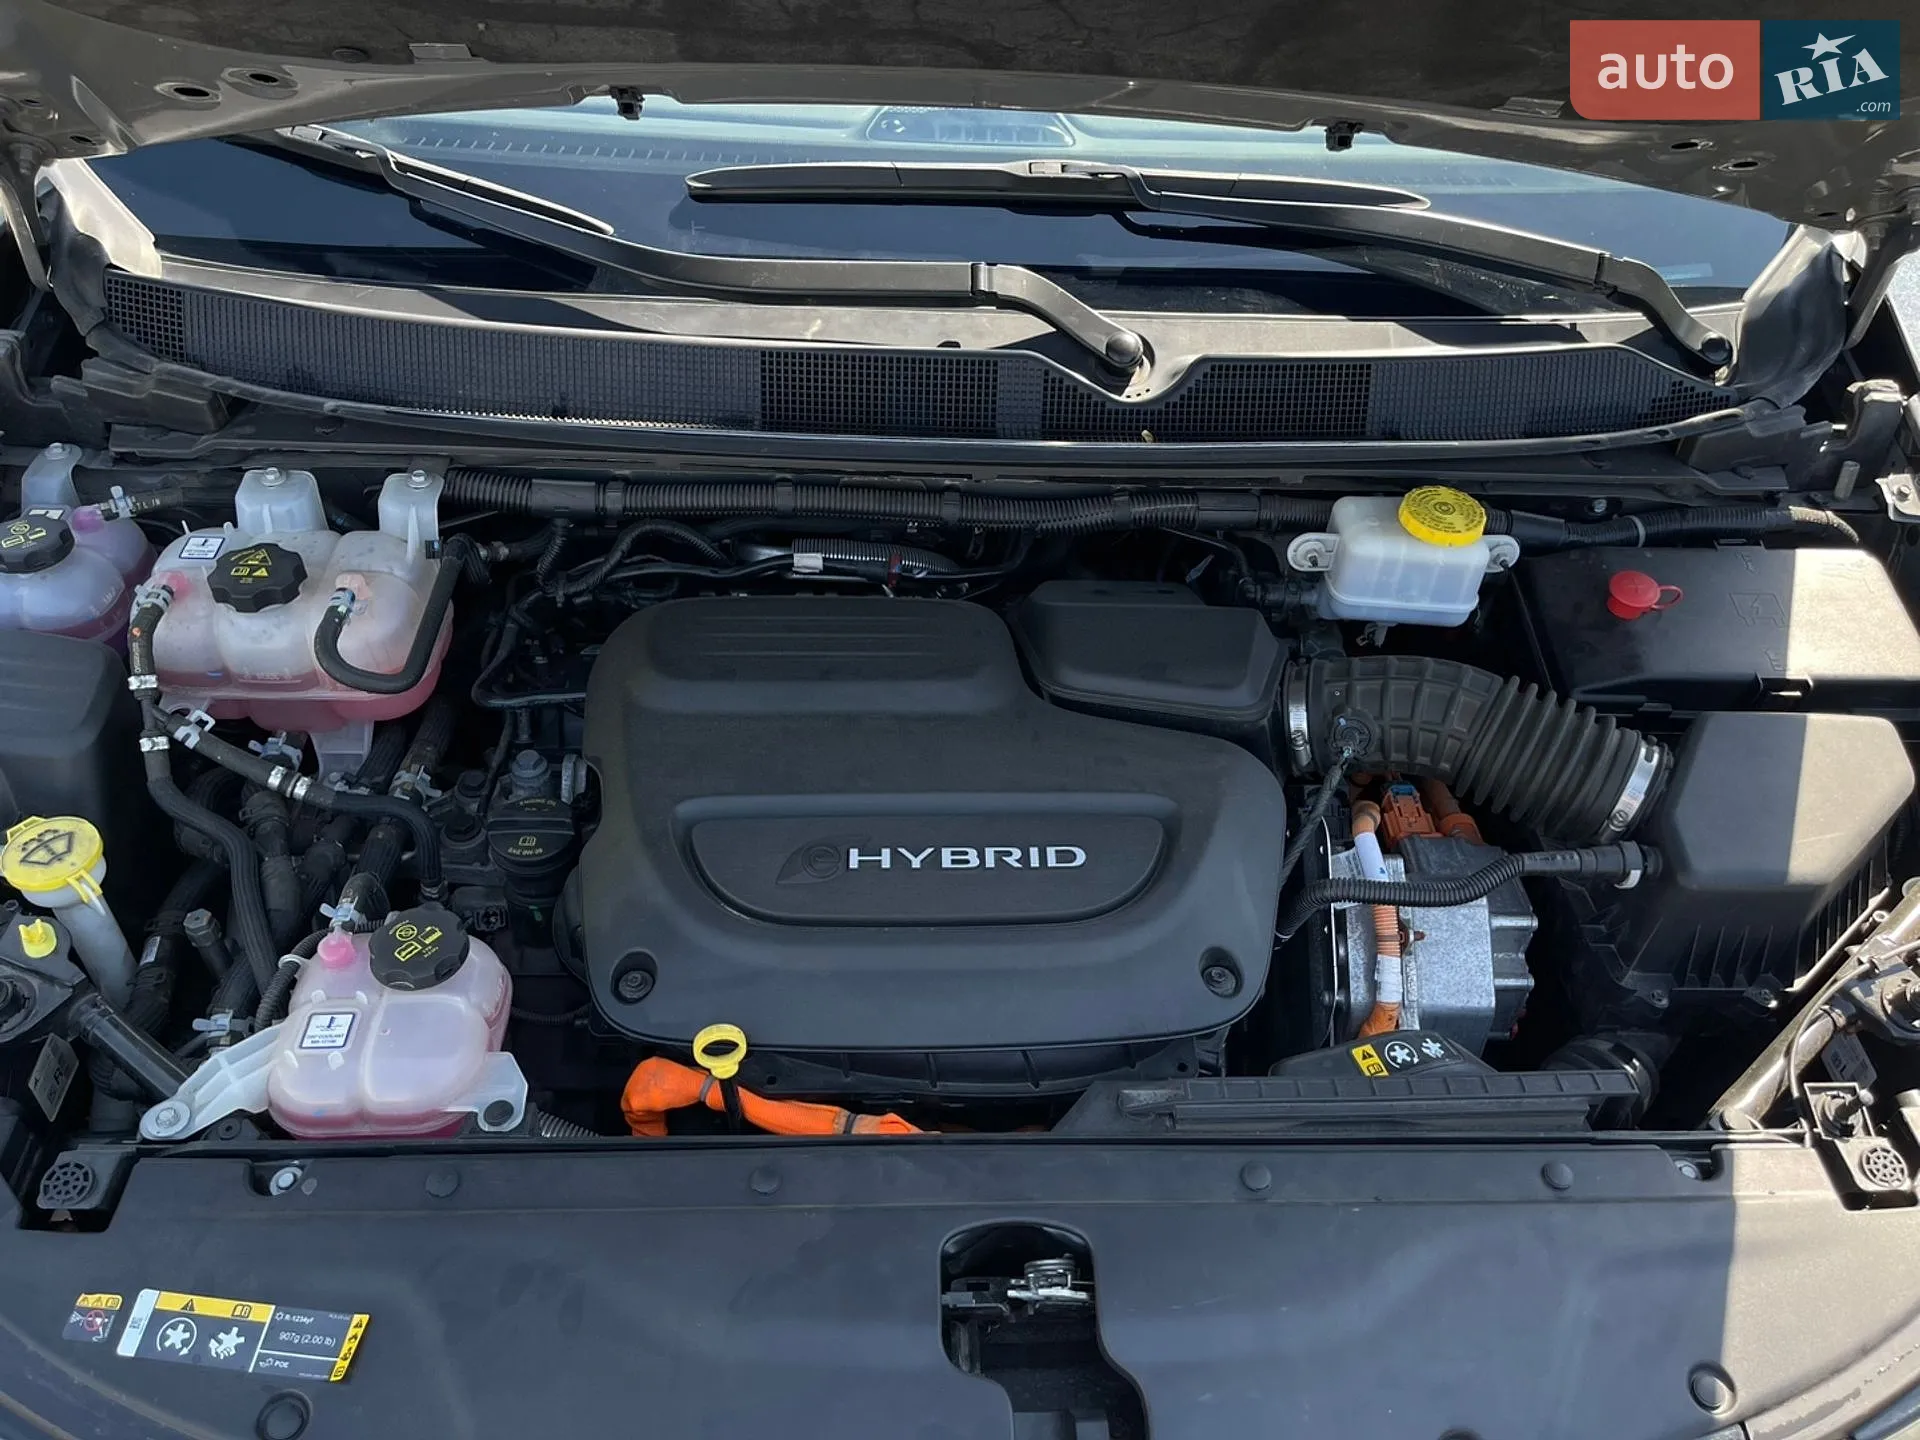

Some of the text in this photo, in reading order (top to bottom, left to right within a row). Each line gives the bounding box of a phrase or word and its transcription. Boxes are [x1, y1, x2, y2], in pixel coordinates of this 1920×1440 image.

[848, 846, 1087, 869] HYBRID
[279, 1331, 301, 1344] 907g
[301, 1334, 324, 1344] (2.00
